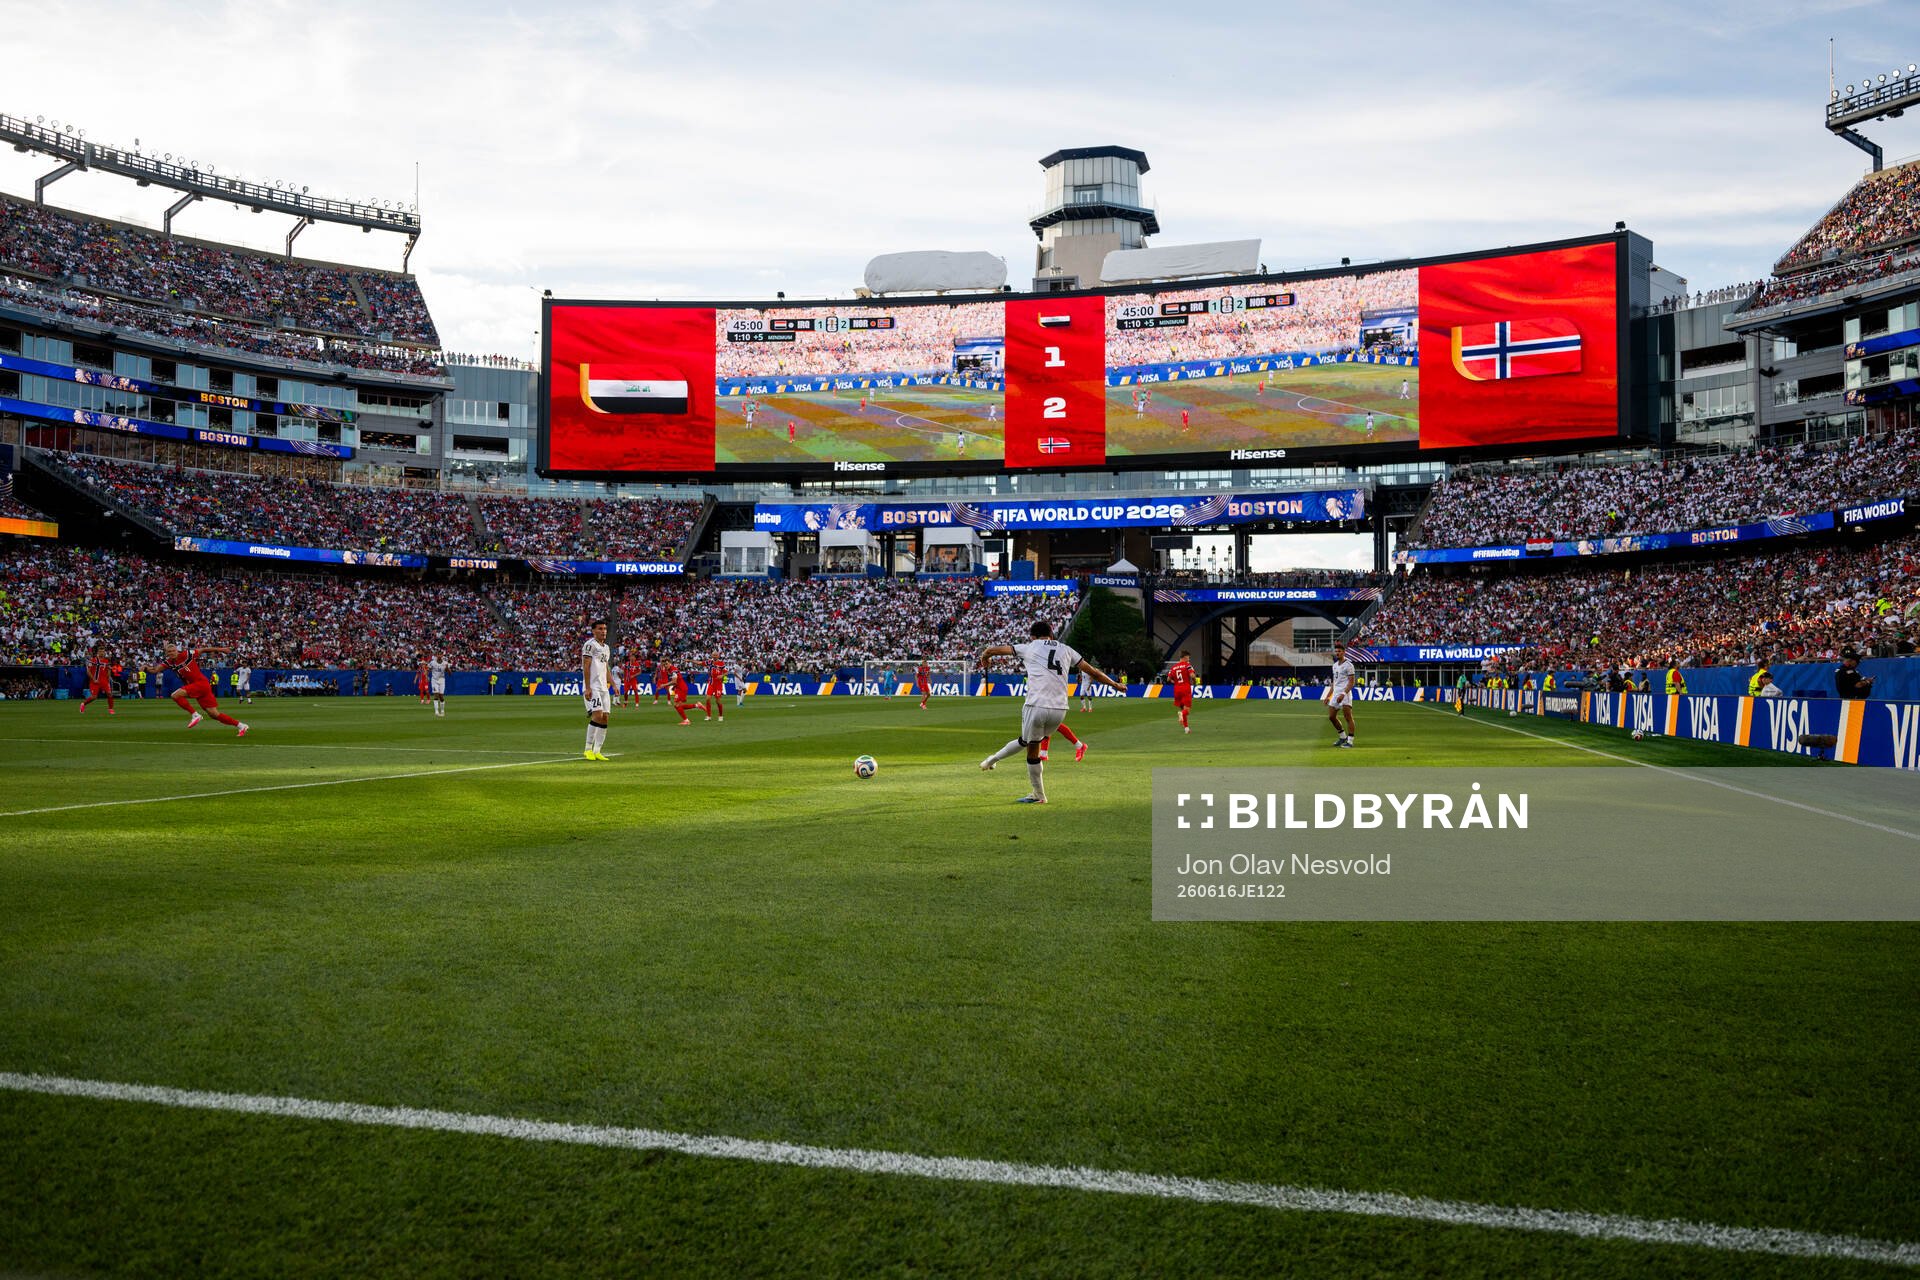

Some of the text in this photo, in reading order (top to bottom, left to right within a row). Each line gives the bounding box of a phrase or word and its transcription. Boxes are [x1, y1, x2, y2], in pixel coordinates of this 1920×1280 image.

[1212, 302, 1217, 310] 1
[1237, 300, 1243, 309] 2
[1250, 298, 1266, 307] NOR
[1123, 306, 1154, 317] 45:00
[733, 321, 763, 331] 45:00
[818, 321, 823, 329] 1
[841, 321, 847, 329] 2
[853, 320, 868, 328] NOR
[1144, 319, 1154, 327] +5
[1045, 347, 1065, 367] 1
[1140, 373, 1159, 383] VISA
[1187, 369, 1206, 378] VISA
[1233, 363, 1250, 373] VISA
[1318, 355, 1336, 364] VISA
[1386, 356, 1398, 365] VISA
[749, 386, 768, 394] VISA
[793, 384, 812, 392] VISA
[836, 381, 853, 390] VISA
[915, 377, 932, 385] VISA
[201, 393, 248, 408] BOSTON
[1044, 397, 1066, 418] 2
[199, 430, 247, 446] BOSTON
[1231, 450, 1286, 460] Hisense
[834, 461, 885, 471] Hisense
[993, 504, 1186, 522] FIFA WORLD CUP 2026
[1228, 500, 1303, 516] BOSTON
[1843, 509, 1863, 523] FIFA
[1864, 503, 1898, 519] WORLD
[883, 510, 952, 524] BOSTON
[1691, 528, 1738, 544] BOSTON
[249, 546, 290, 558] #FIFAWorldCup
[1473, 549, 1520, 559] #FIFAWorldCup
[450, 558, 497, 569] BOSTON
[615, 563, 638, 573] FIFA
[639, 563, 677, 573] WORLD
[1094, 577, 1136, 586] BOSTON
[1217, 591, 1236, 599] FIFA
[1237, 591, 1267, 599] WORLD
[1419, 648, 1444, 659] FIFA
[1445, 648, 1482, 659] WORLD
[1048, 650, 1063, 675] 4
[1176, 670, 1184, 683] 5
[548, 683, 580, 696] VISA
[770, 683, 803, 696] VISA
[847, 683, 880, 696] VISA
[928, 683, 960, 696] VISA
[1007, 684, 1029, 697] VI
[1089, 684, 1127, 698] VISA
[1190, 685, 1214, 699] SA
[1264, 686, 1303, 700] VISA
[1354, 687, 1395, 701] VISA
[591, 698, 601, 708] 24
[1595, 693, 1920, 771] VISA VISA VISA VISA VI
